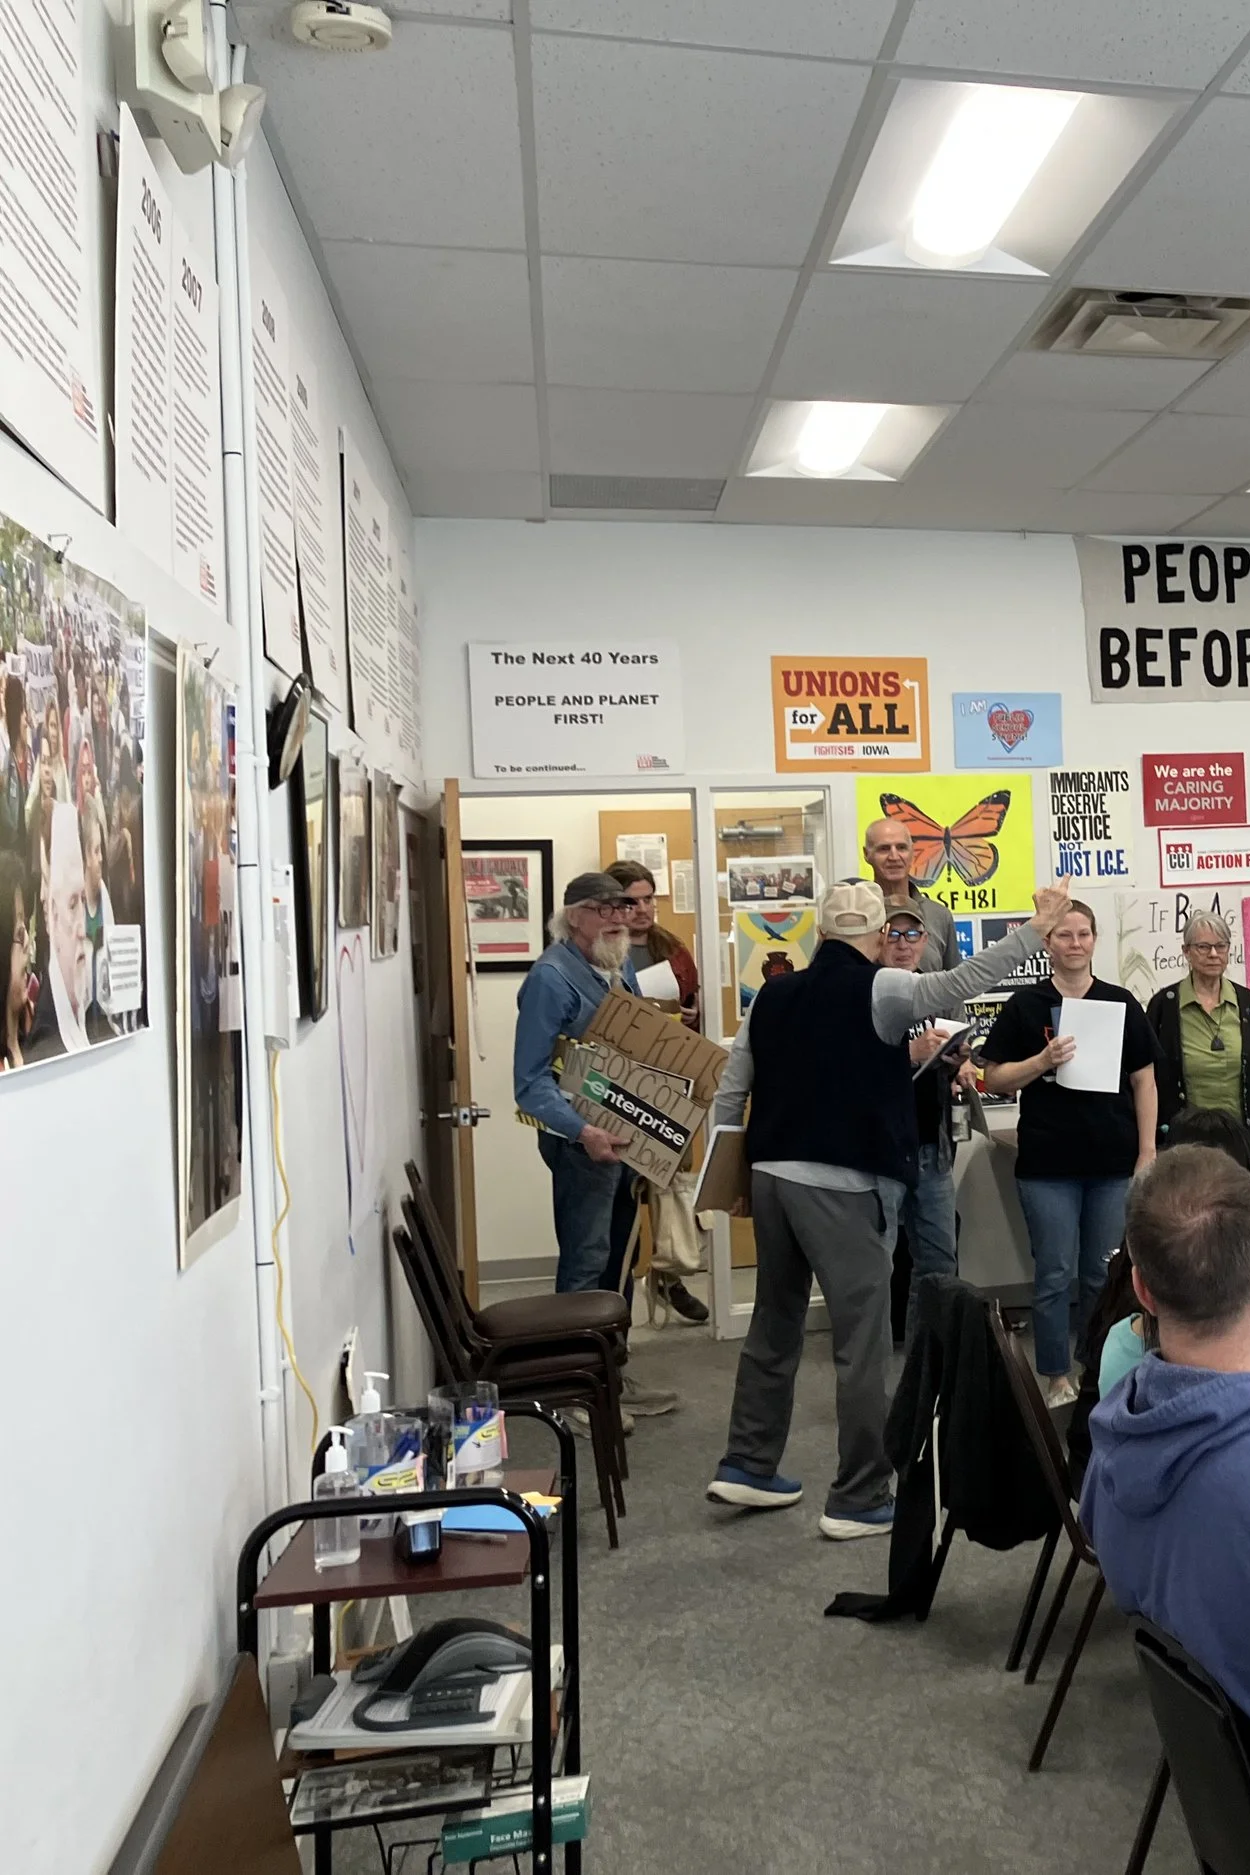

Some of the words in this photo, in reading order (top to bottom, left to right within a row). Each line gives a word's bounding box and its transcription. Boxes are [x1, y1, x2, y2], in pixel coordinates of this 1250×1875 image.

[142, 177, 161, 245] 2006
[182, 257, 202, 313] 2007
[491, 652, 526, 665] The
[532, 652, 575, 664] Next
[580, 652, 602, 664] 40
[608, 652, 659, 664] Years
[781, 670, 901, 697] UNIONS
[495, 695, 555, 706] PEOPLE
[561, 695, 594, 706] AND
[599, 694, 659, 705] PLANET
[961, 703, 966, 716] I
[970, 699, 987, 714] AM
[554, 713, 604, 724] FIRST!
[792, 710, 818, 724] for
[827, 703, 909, 735] ALL
[862, 745, 889, 755] IOWA
[494, 765, 507, 773] To
[526, 764, 586, 772] continued...
[1154, 765, 1179, 778] We
[1182, 766, 1205, 778] are
[1209, 763, 1233, 777] the
[1050, 771, 1129, 793] IMMIGRANTS
[1163, 780, 1224, 794] CARING
[1051, 793, 1107, 816] DESERVE
[1155, 796, 1234, 811] MAJORITY
[1053, 815, 1112, 842] JUSTICE
[1059, 841, 1083, 851] NOT
[1056, 850, 1091, 877] JUST
[1096, 849, 1129, 876] I.C.E.
[1169, 853, 1190, 869] CCI
[1197, 853, 1243, 870] ACTION
[964, 888, 997, 910] 481
[1148, 902, 1169, 933] IF
[590, 992, 653, 1054] ICE
[584, 1079, 685, 1146] enterprise
[490, 1832, 511, 1844] Face
